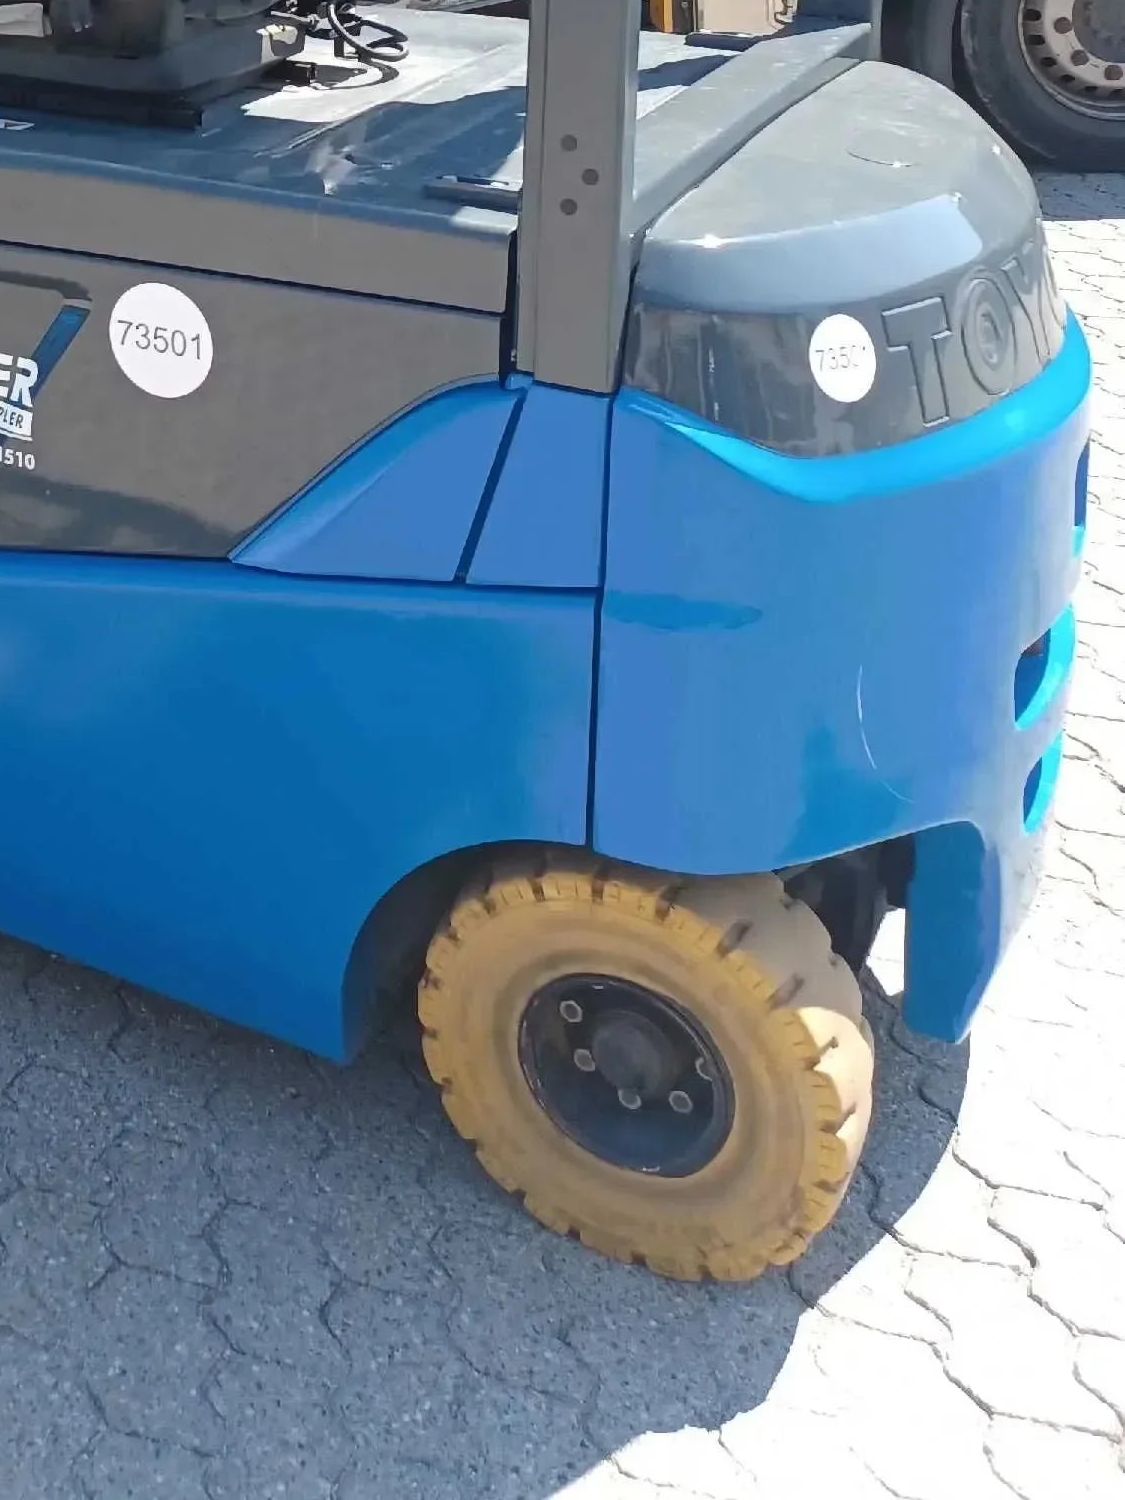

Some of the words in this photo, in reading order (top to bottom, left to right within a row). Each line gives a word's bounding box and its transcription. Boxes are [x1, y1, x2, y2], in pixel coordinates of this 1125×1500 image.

[117, 319, 201, 360] 73501
[881, 238, 1063, 427] TOY
[815, 345, 866, 372] 735
